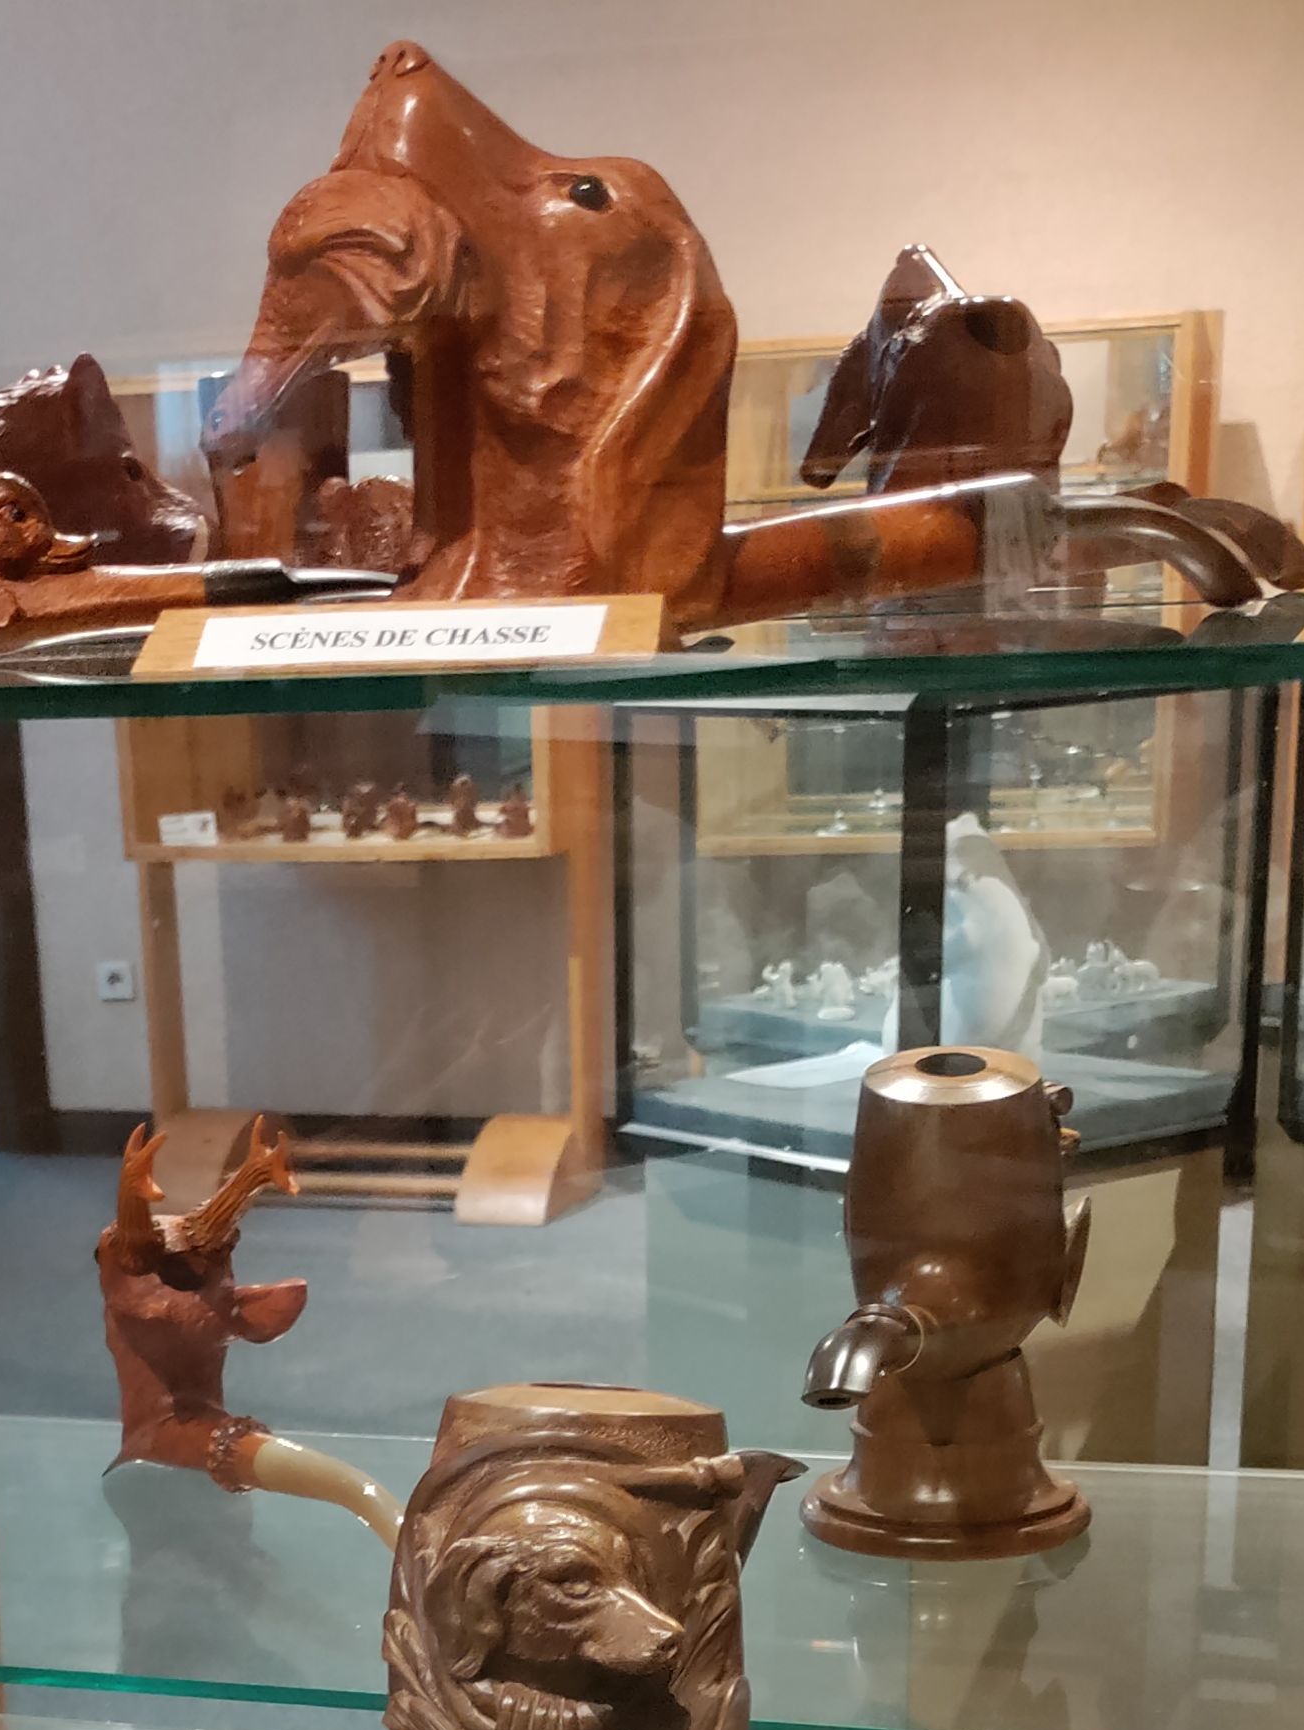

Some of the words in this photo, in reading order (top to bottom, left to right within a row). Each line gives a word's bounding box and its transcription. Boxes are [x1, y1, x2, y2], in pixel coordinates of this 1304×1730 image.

[250, 626, 369, 650] SCÈNES
[374, 629, 418, 647] DE
[425, 625, 551, 646] CHASSE
